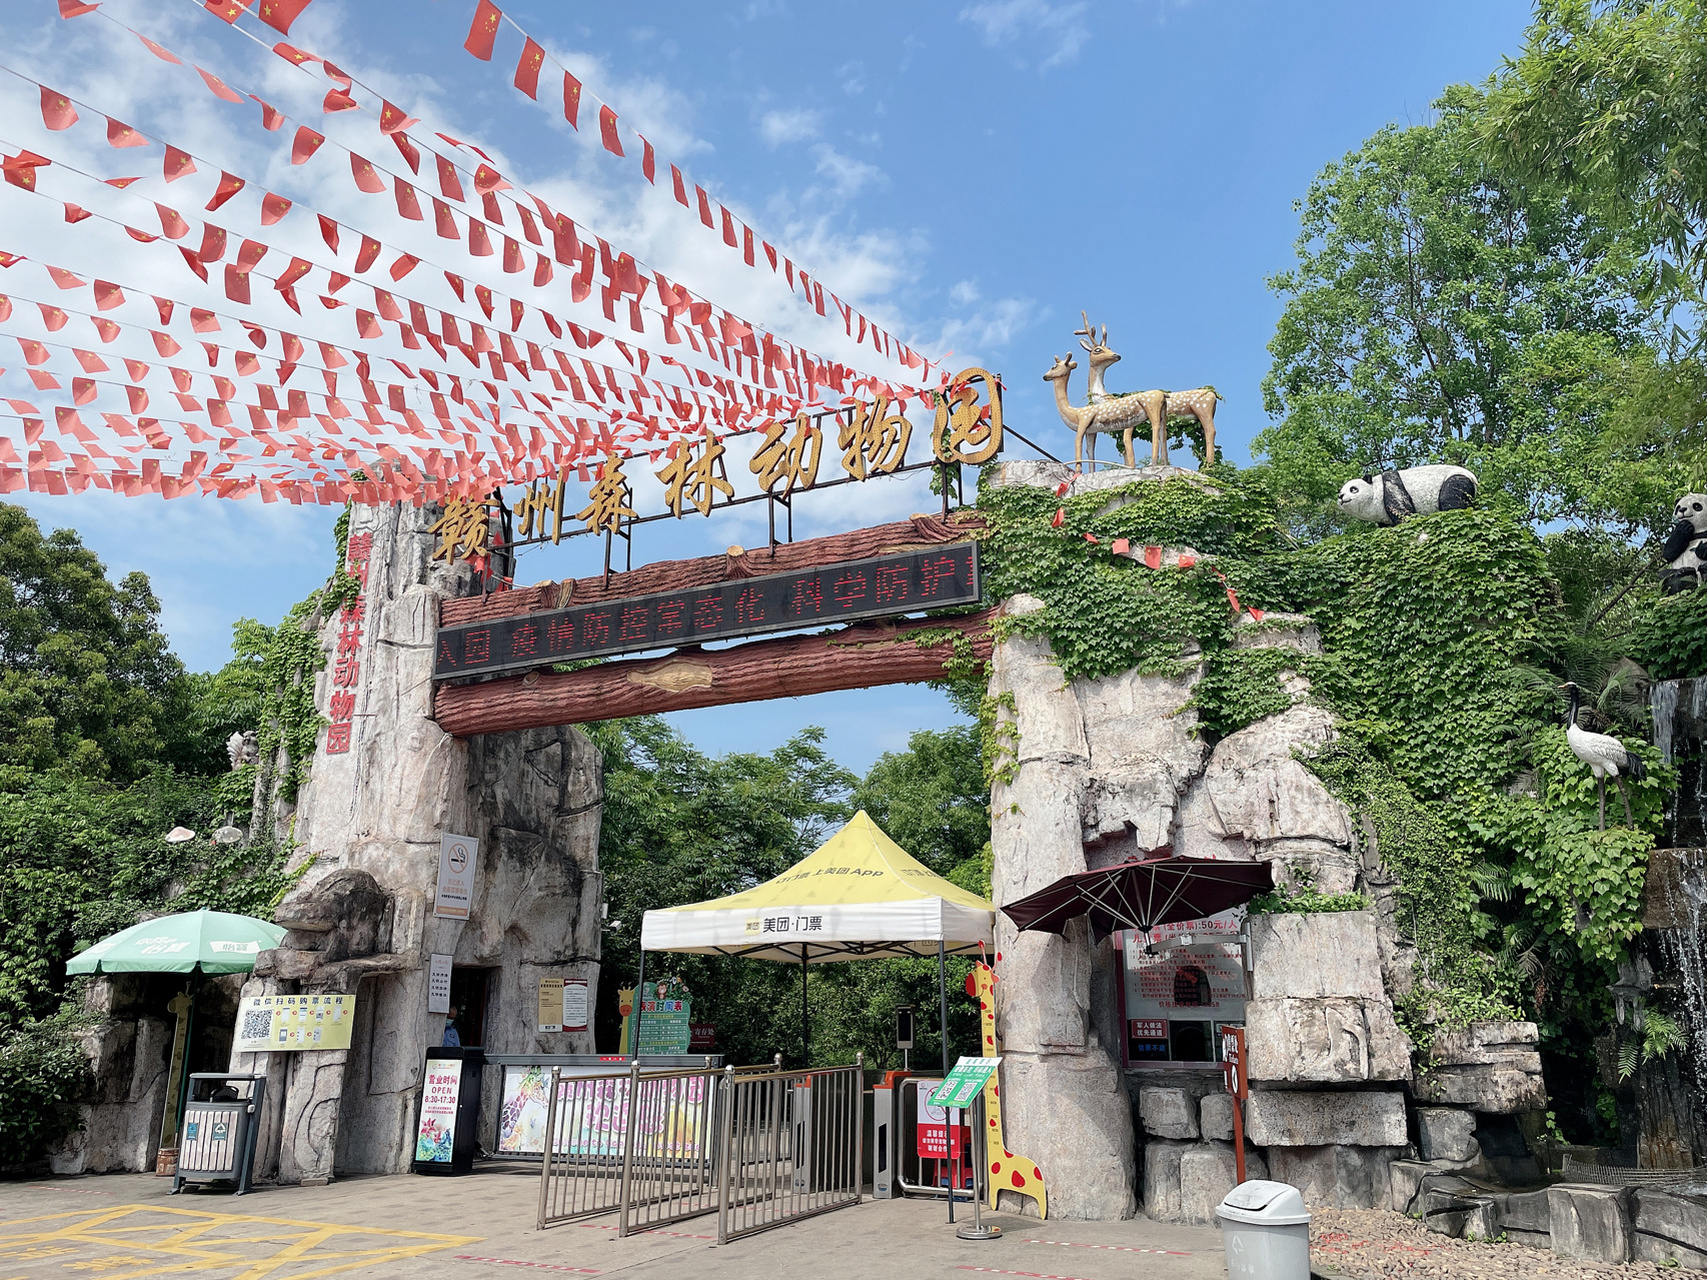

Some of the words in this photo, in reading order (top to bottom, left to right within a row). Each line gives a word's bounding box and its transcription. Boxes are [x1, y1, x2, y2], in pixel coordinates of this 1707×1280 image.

[428, 367, 1003, 566] 赣州森林动物园
[511, 588, 765, 658] 疫情防控常态化
[850, 868, 884, 877] App
[763, 916, 823, 933] 美团·门票
[253, 996, 344, 1006] 微信扫码购票流程
[690, 1027, 715, 1036] 寄存处
[428, 1074, 457, 1085] 营业时间
[431, 1086, 452, 1095] OPEN
[424, 1095, 456, 1104] 8:30-17:30
